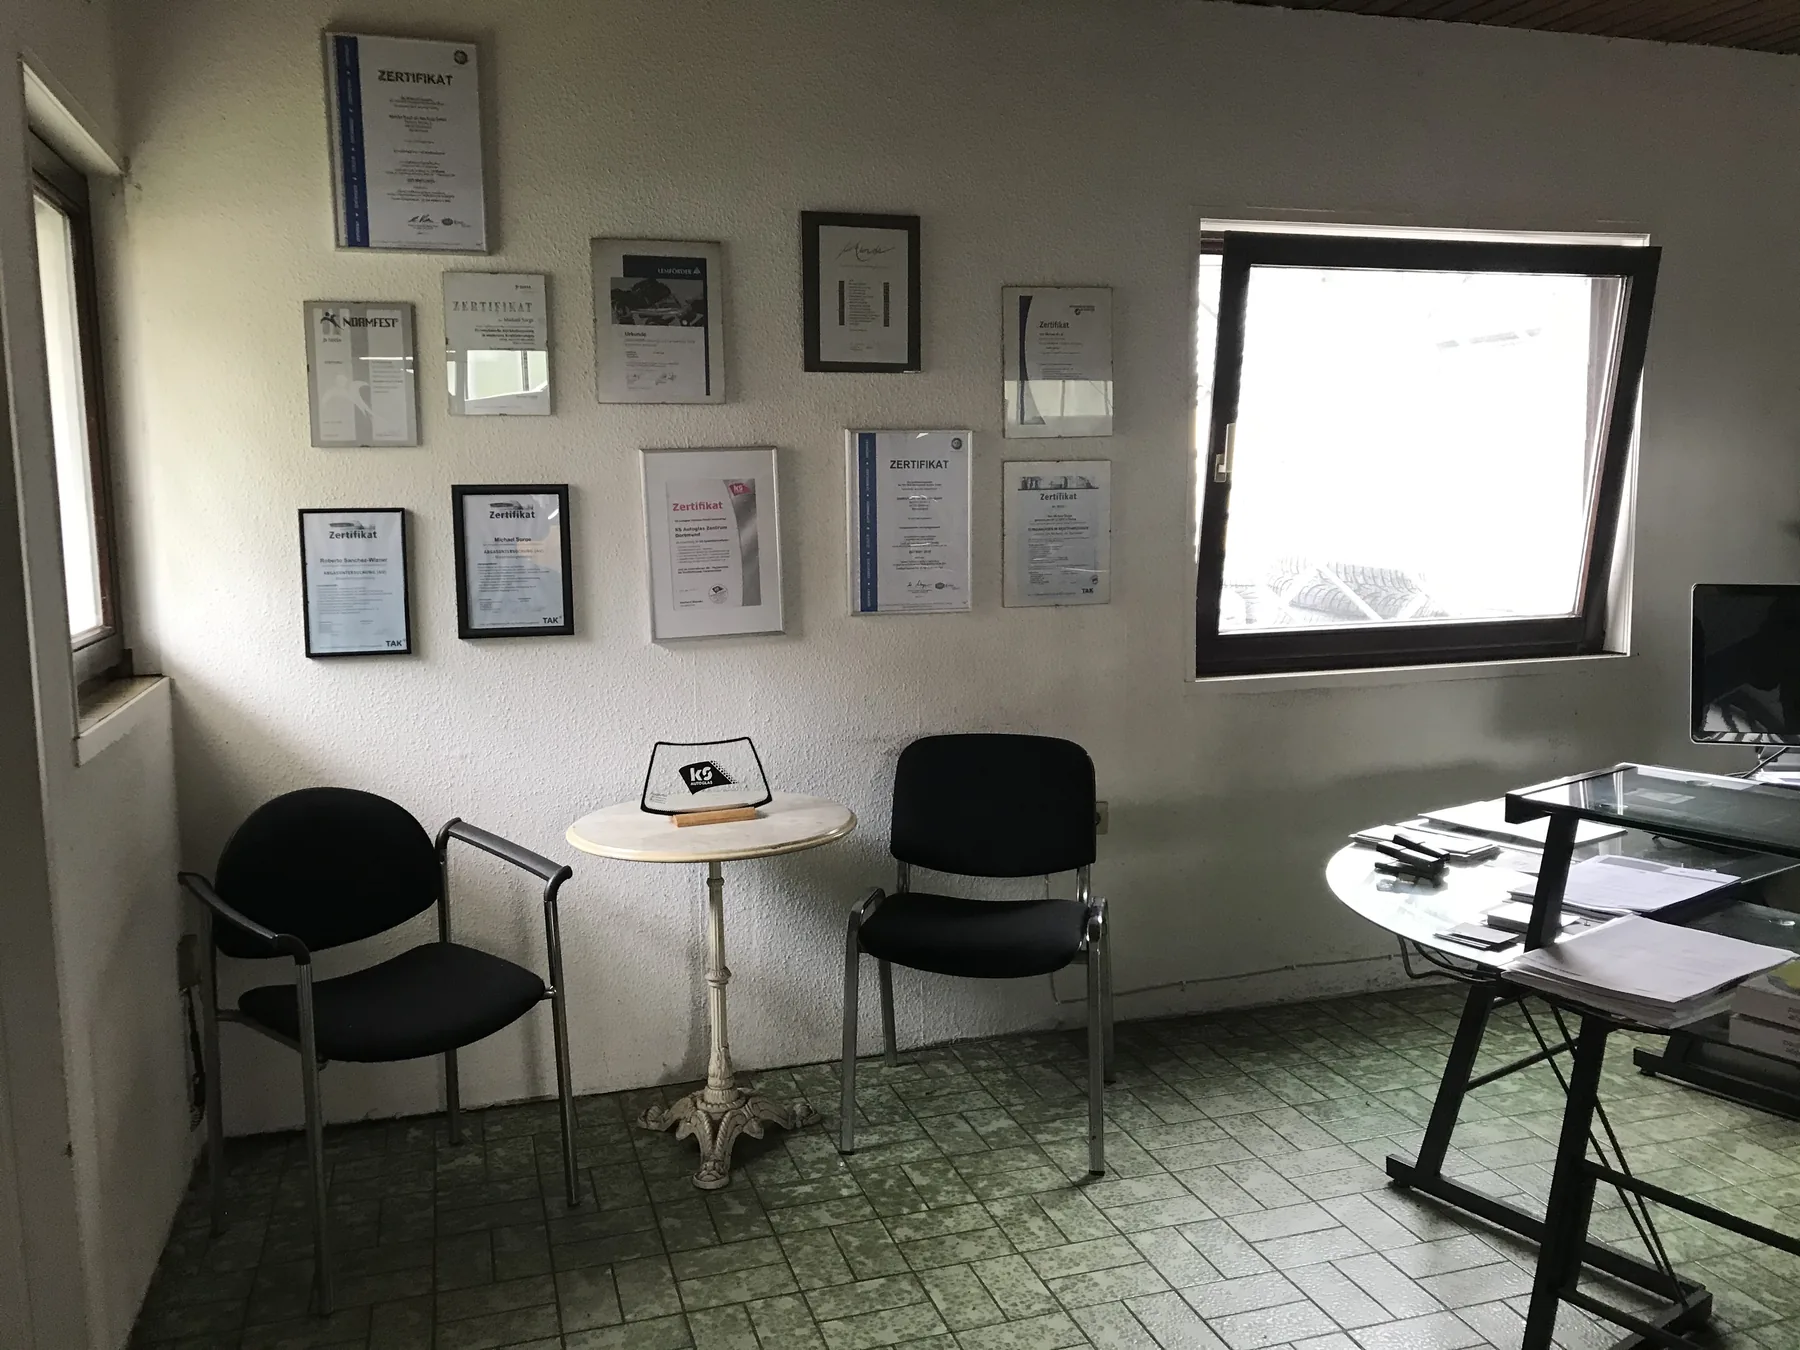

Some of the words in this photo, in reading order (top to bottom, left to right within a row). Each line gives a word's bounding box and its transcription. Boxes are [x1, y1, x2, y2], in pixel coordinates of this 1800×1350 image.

[378, 70, 453, 86] ZERTIFIKAT
[452, 301, 533, 313] ZERTIFIKAT
[890, 460, 950, 469] ZERTIFIKAT
[1040, 492, 1077, 500] Zertifikat
[672, 501, 723, 511] Zertifikat
[489, 510, 536, 519] Zertifikat
[329, 530, 378, 539] Zertifikat
